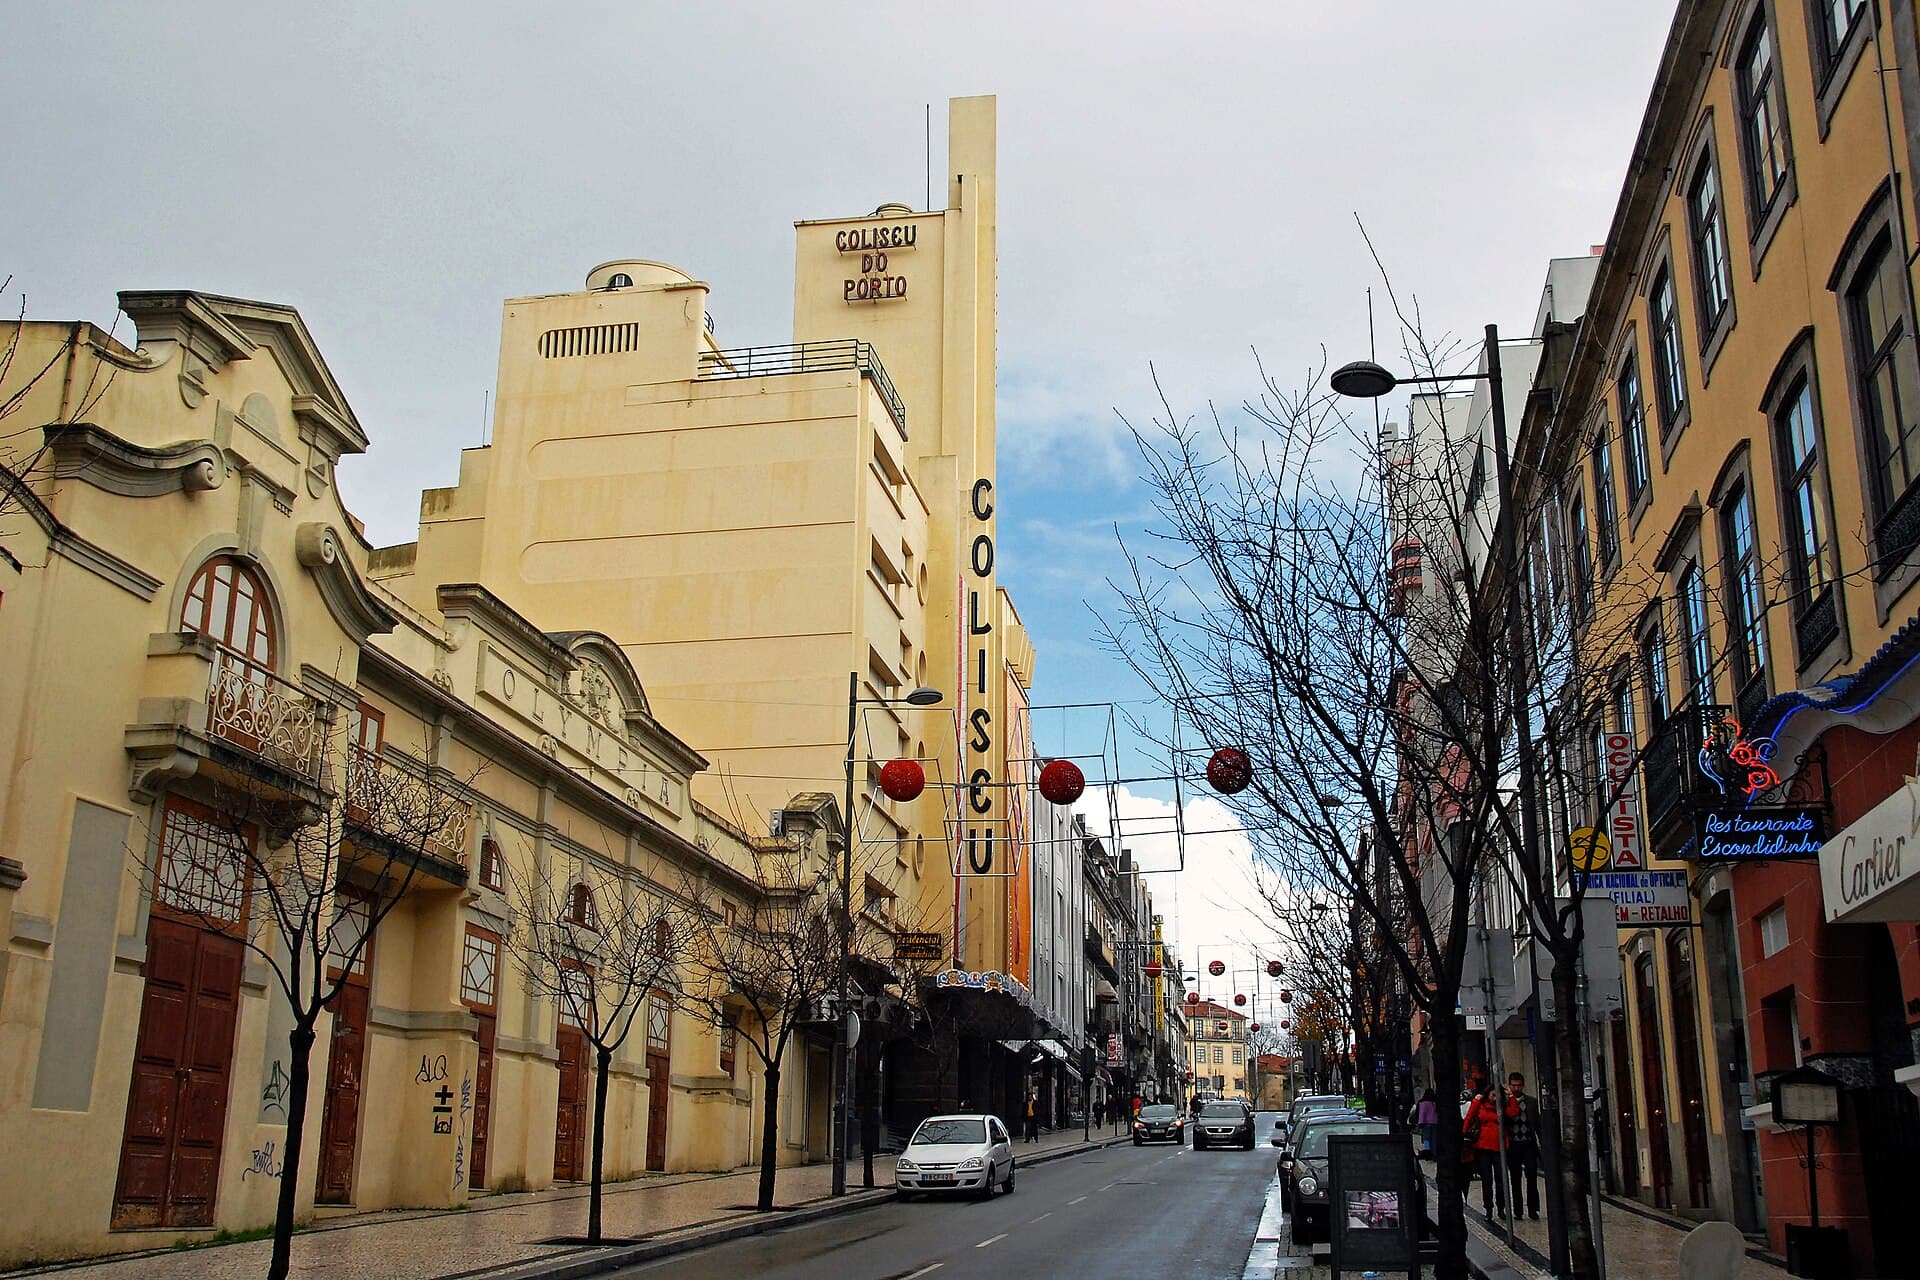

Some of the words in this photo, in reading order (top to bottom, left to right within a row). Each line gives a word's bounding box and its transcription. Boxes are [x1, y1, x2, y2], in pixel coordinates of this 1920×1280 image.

[836, 225, 917, 250] COLISEU
[861, 252, 888, 273] DO
[843, 275, 907, 301] PORTO
[969, 478, 993, 875] COLISEU
[503, 669, 670, 806] OLYMPIA
[1607, 735, 1639, 865] OCULISTA
[1705, 812, 1814, 833] Restaurante
[1701, 833, 1822, 856] Escondidinho
[1605, 873, 1640, 889] NACIONAL
[1640, 874, 1650, 888] de
[1841, 835, 1905, 904] Cartier
[1609, 890, 1655, 904] (FILIAL)
[1641, 906, 1688, 920] RETALHO
